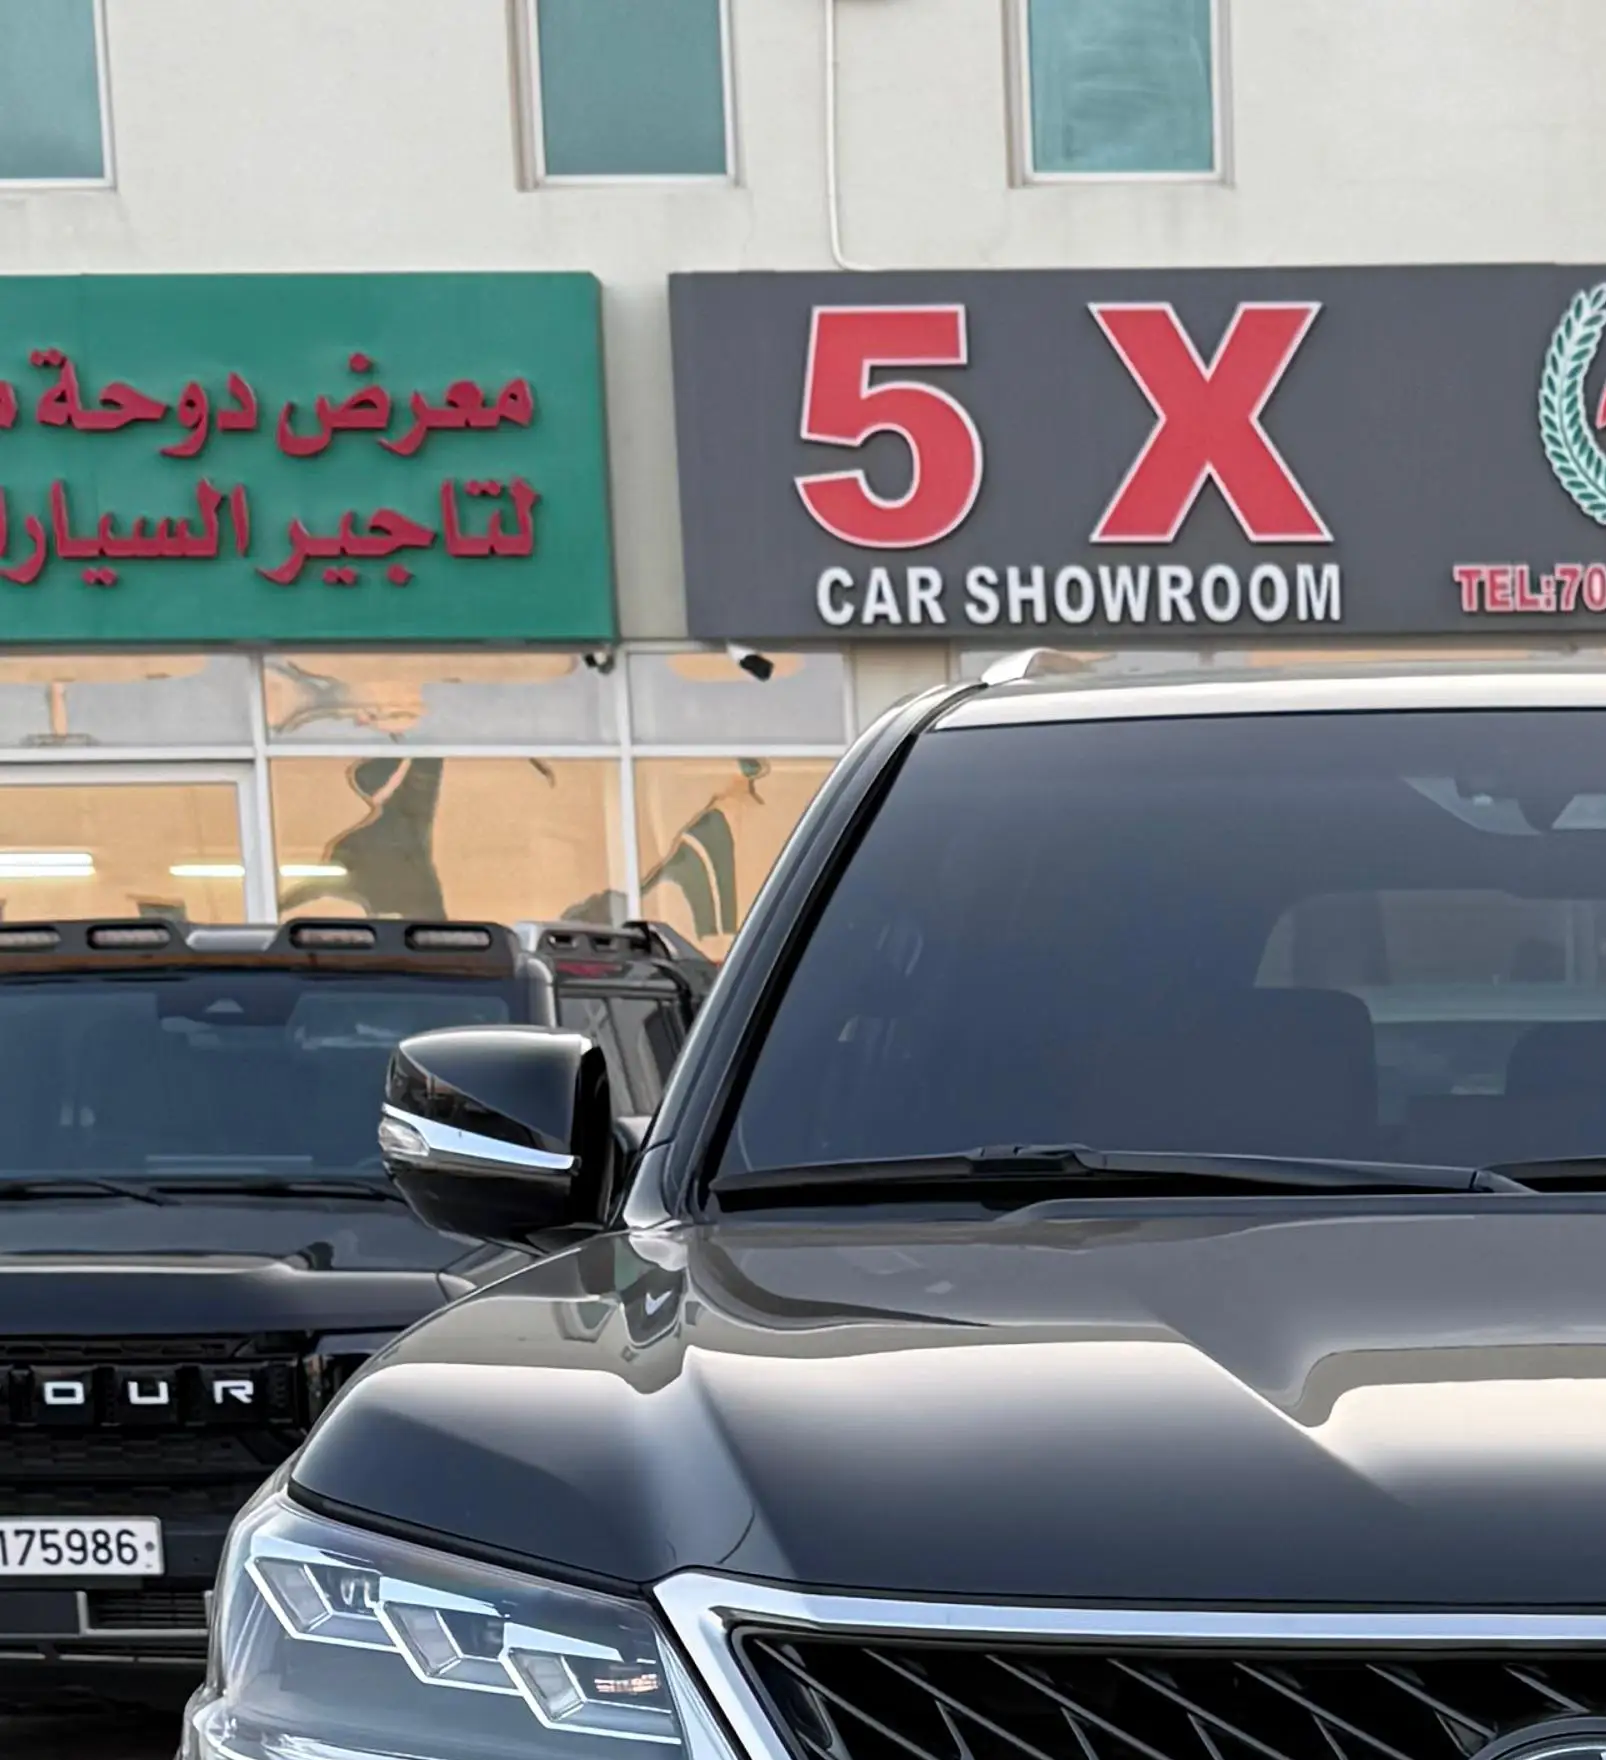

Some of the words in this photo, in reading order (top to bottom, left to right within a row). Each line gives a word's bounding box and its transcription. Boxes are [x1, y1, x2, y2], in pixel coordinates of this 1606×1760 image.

[29, 347, 258, 458] دوحة
[276, 351, 534, 457] معرض
[795, 304, 984, 550] 5
[1087, 302, 1334, 543] X
[256, 476, 541, 585] لتاجير
[816, 566, 947, 626] CAR
[964, 562, 1342, 625] SHOWROOM
